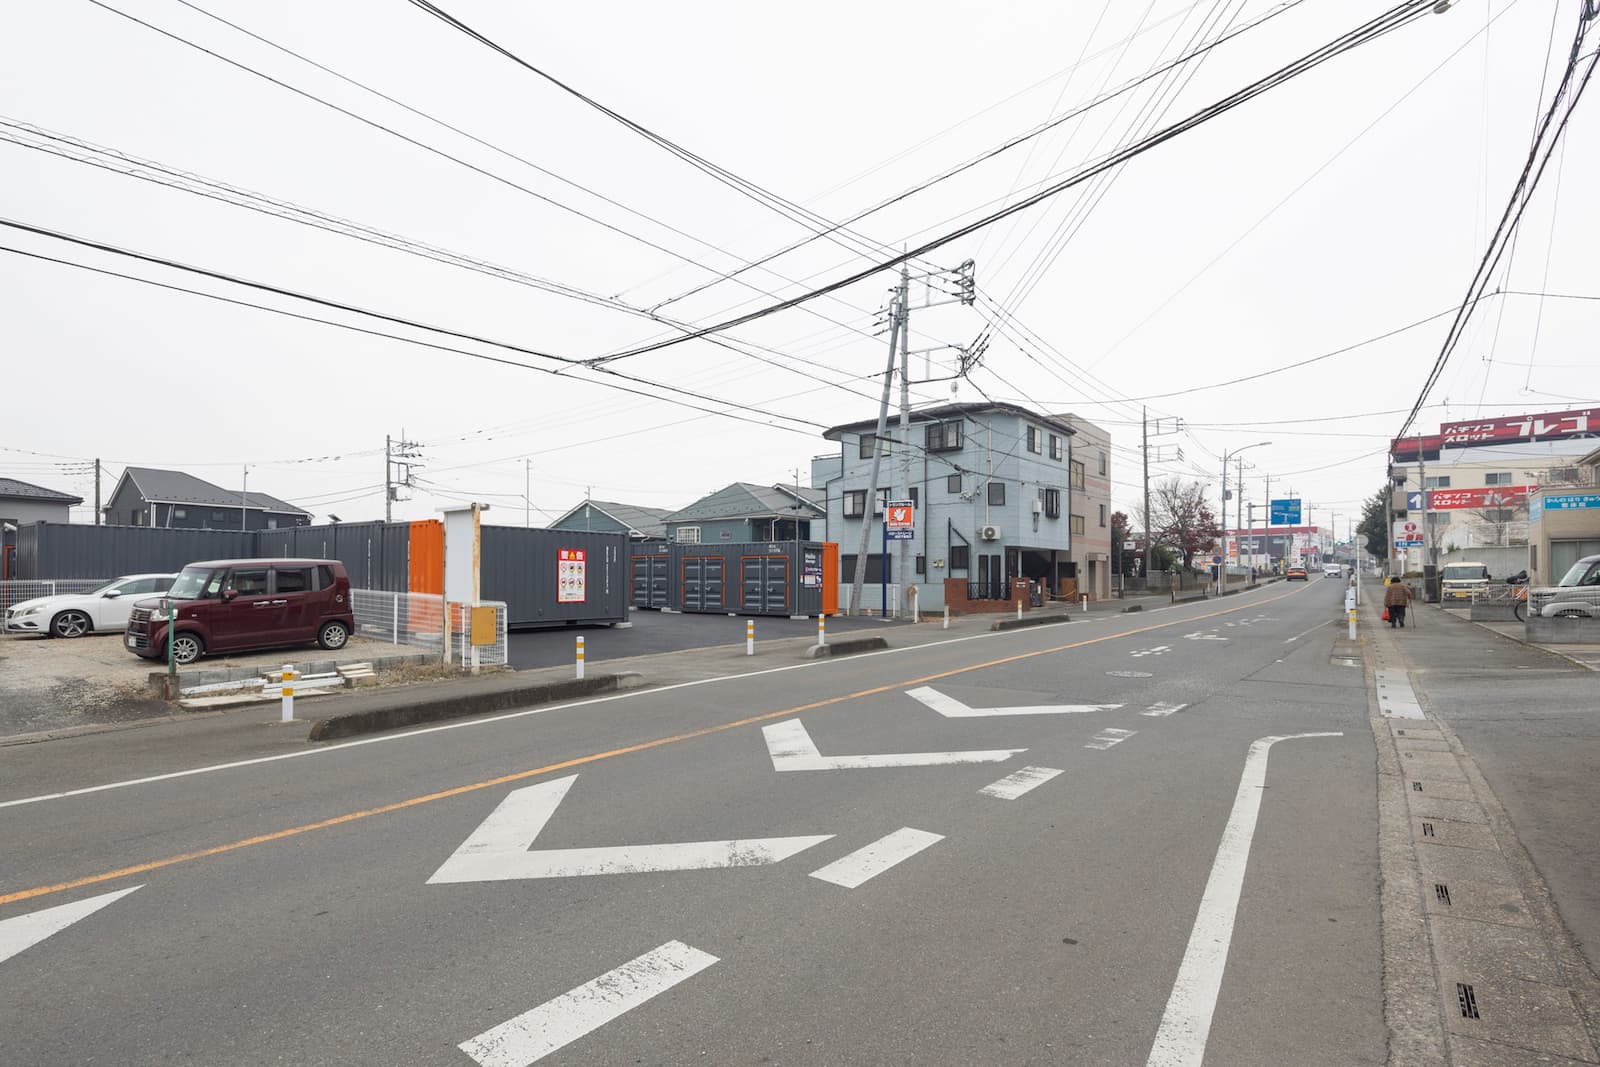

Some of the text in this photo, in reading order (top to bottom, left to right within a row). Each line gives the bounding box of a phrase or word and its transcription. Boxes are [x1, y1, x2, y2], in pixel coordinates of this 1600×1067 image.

[1506, 411, 1591, 436] プレゴ
[1445, 424, 1495, 433] パチンコ
[1444, 433, 1495, 443] スロット
[1433, 492, 1471, 500] パチンコ
